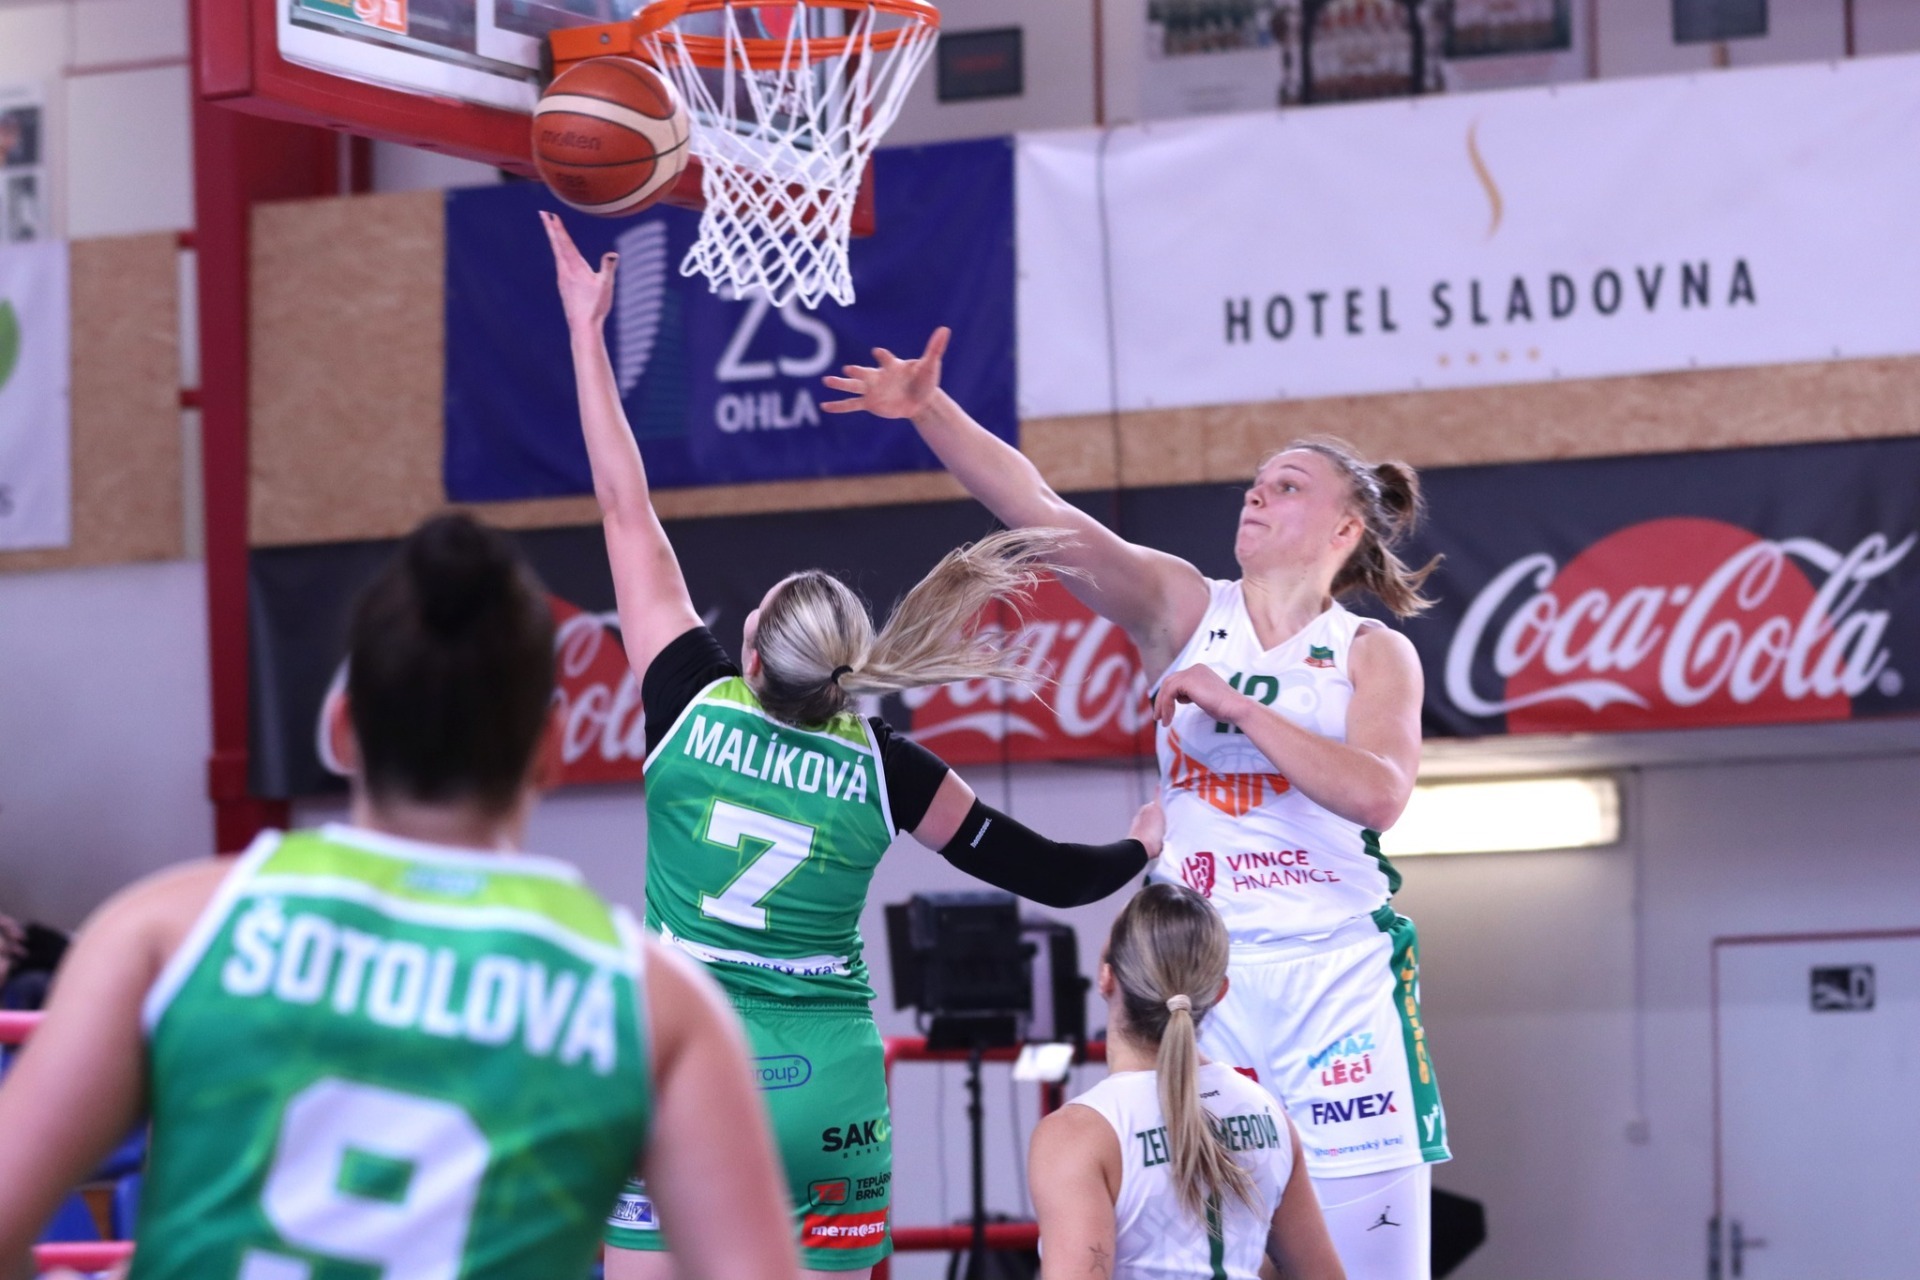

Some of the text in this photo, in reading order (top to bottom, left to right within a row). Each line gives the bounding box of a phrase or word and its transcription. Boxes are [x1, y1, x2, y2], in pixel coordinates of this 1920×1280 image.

[1225, 258, 1757, 343] HOTEL SLADOVNA
[1445, 532, 1916, 718] Coca-Cola
[683, 714, 868, 804] MALÍKOVÁ
[701, 799, 818, 930] 7
[1225, 850, 1310, 871] VINICE
[1232, 868, 1341, 892] HNANICE
[221, 890, 618, 1076] ŠOTOLOVÁ
[755, 1064, 801, 1084] roup
[1321, 1053, 1372, 1086] LÉČÍ
[1311, 1091, 1398, 1125] FAVEX
[260, 1077, 492, 1280] 9
[855, 1186, 885, 1201] BRNO
